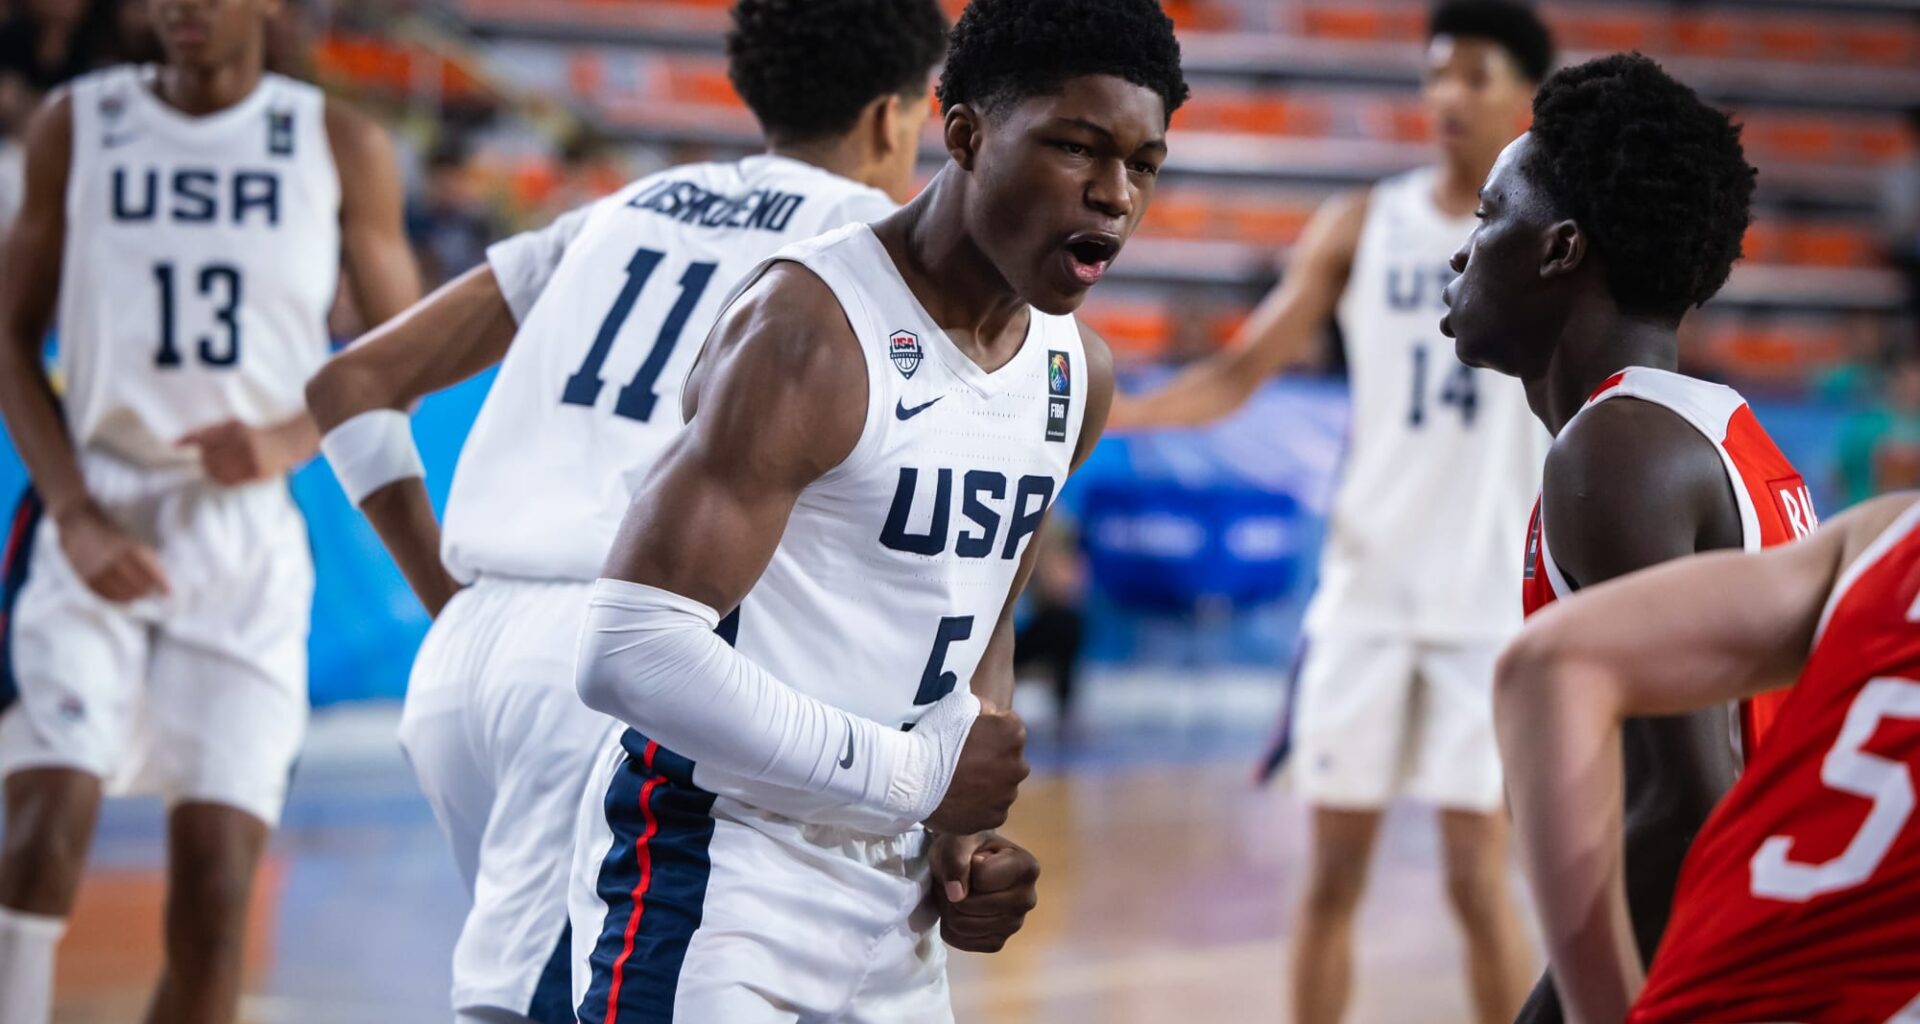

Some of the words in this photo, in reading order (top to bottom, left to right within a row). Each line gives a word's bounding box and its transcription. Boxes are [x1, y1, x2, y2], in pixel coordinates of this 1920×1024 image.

[112, 167, 280, 226] USA
[154, 262, 242, 367] 13
[561, 247, 719, 422] 11
[1050, 403, 1065, 419] FIBA
[1410, 345, 1478, 427] 14
[879, 467, 1055, 560] USA
[1749, 676, 1920, 901] 5
